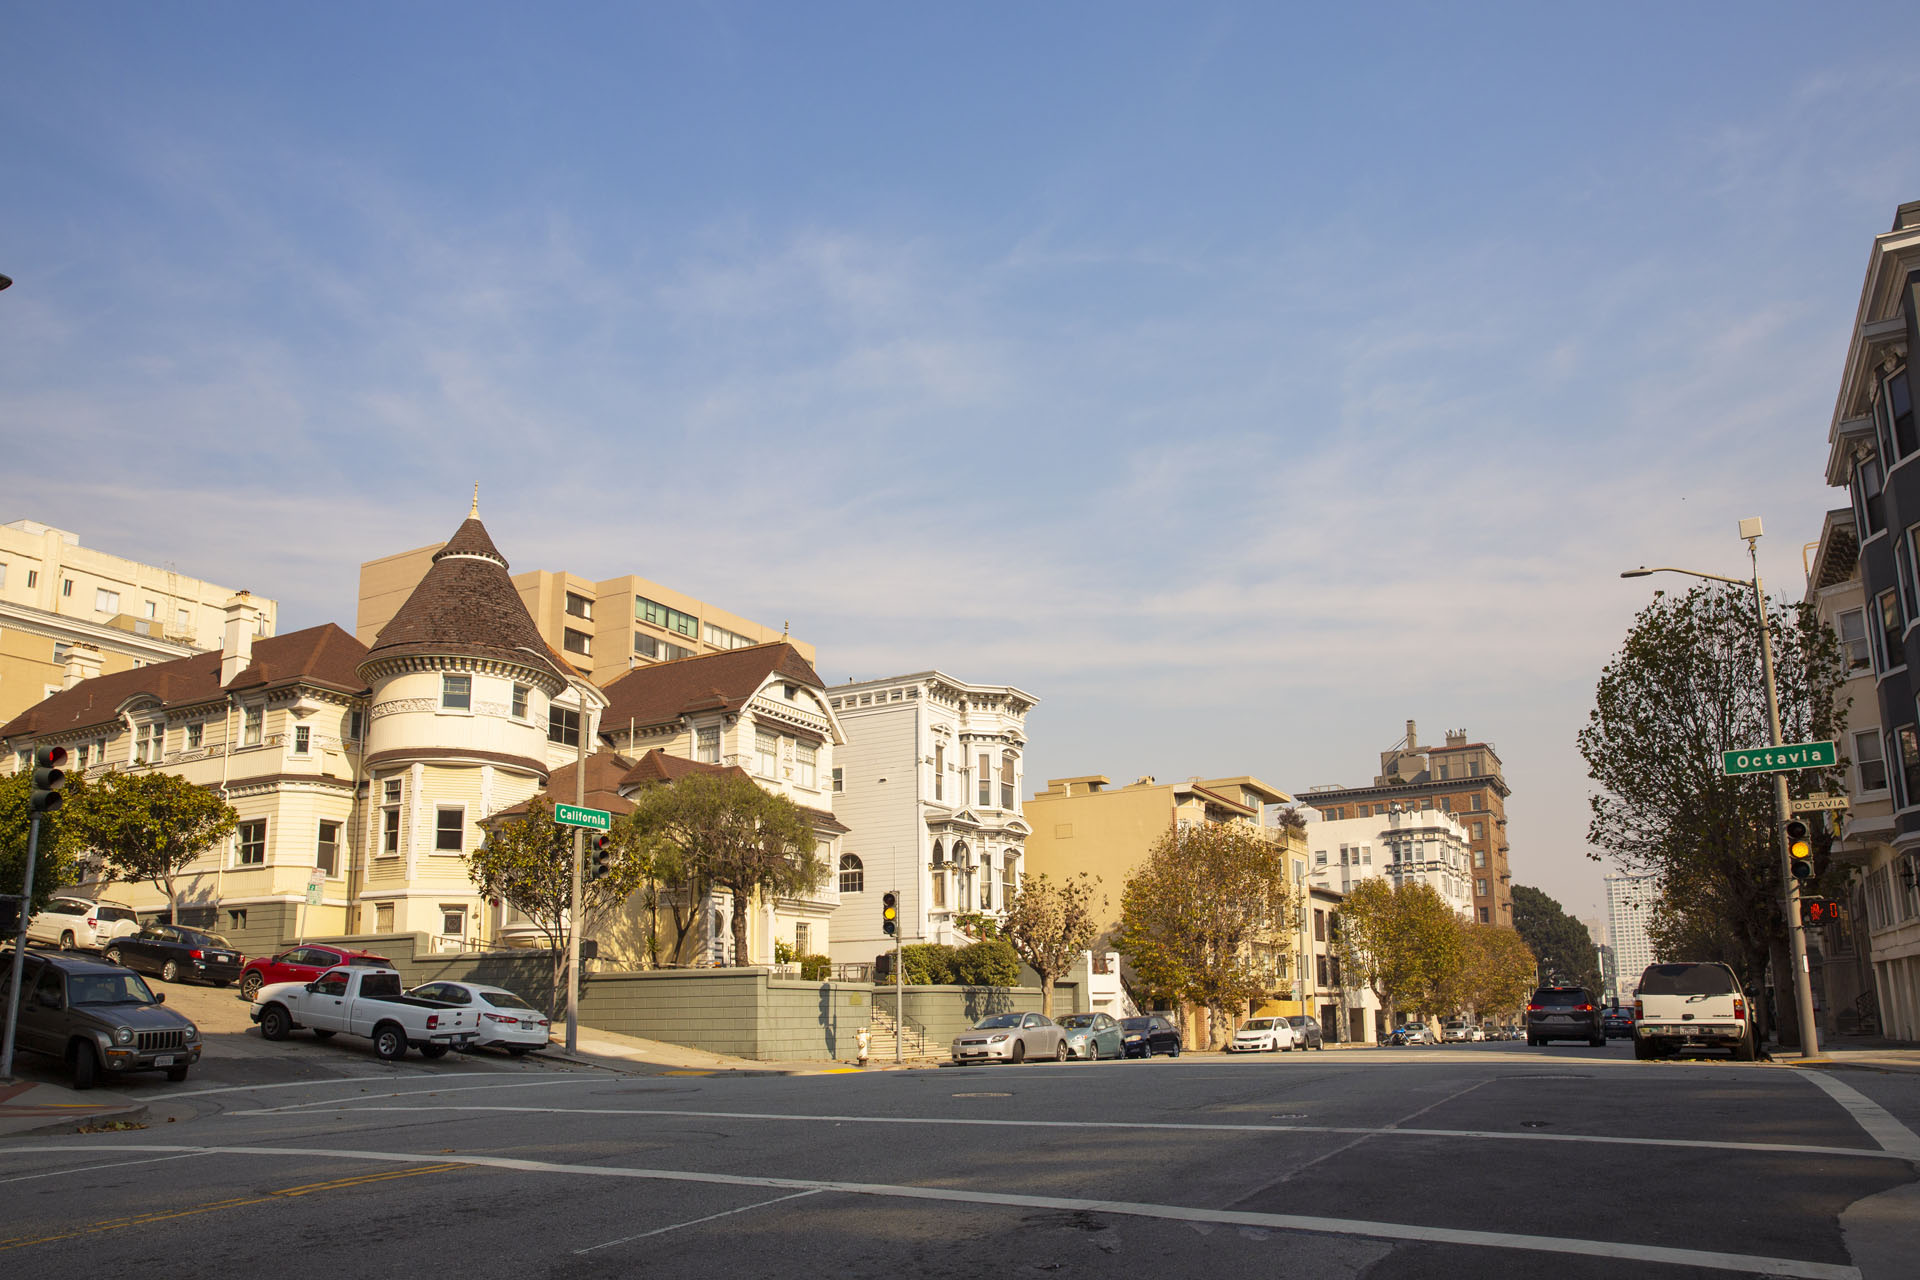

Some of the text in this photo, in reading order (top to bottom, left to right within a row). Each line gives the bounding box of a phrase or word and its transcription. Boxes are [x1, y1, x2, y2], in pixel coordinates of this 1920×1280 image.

[1737, 749, 1821, 768] Octavia
[1794, 799, 1846, 810] OCTAVIA
[560, 808, 606, 826] California
